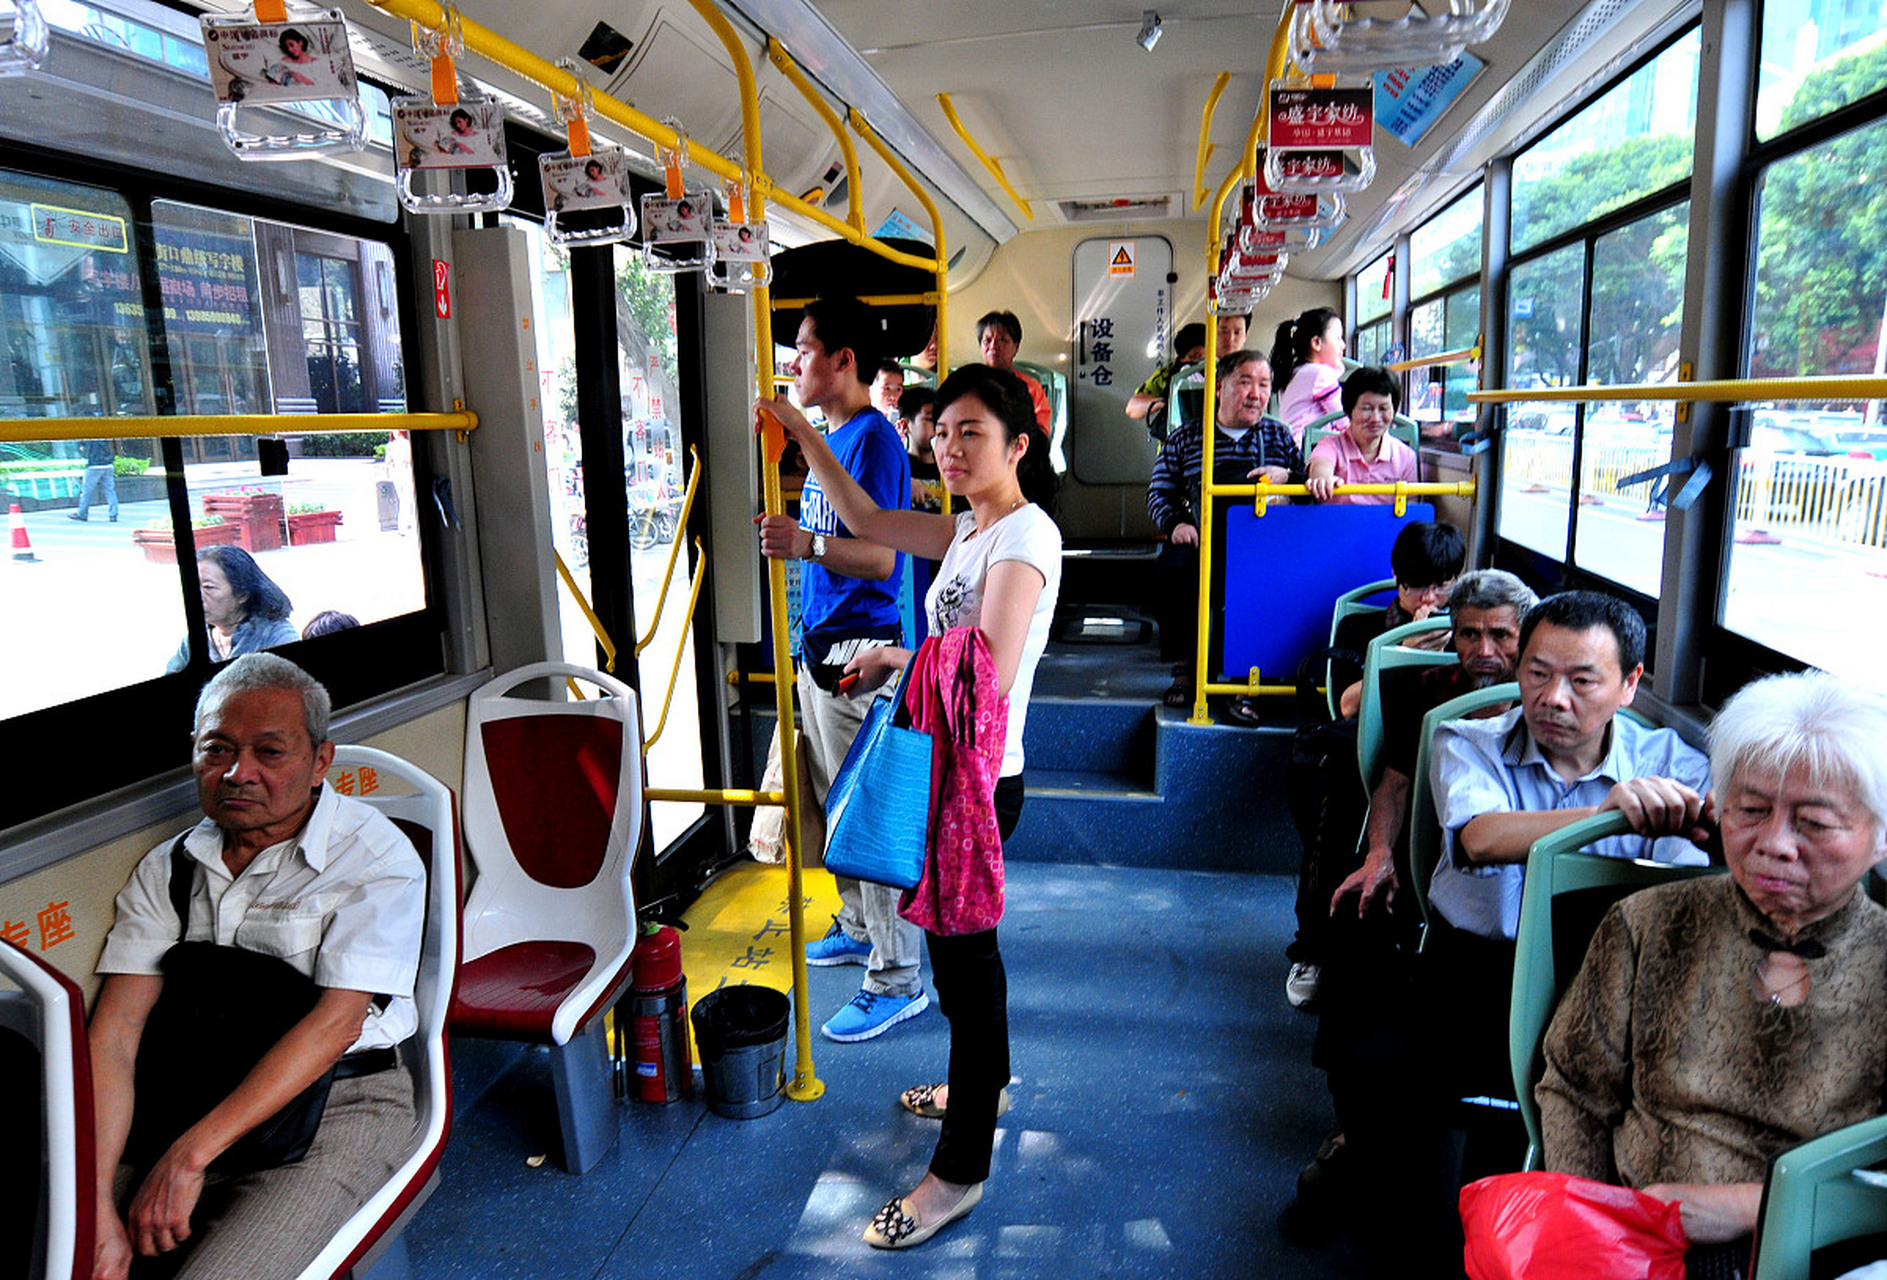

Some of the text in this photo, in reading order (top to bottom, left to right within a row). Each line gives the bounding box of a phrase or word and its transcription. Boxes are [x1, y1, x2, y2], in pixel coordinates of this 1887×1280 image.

[69, 219, 123, 239] 安全出口
[1091, 318, 1114, 386] 设备仓
[336, 767, 379, 797] 专座
